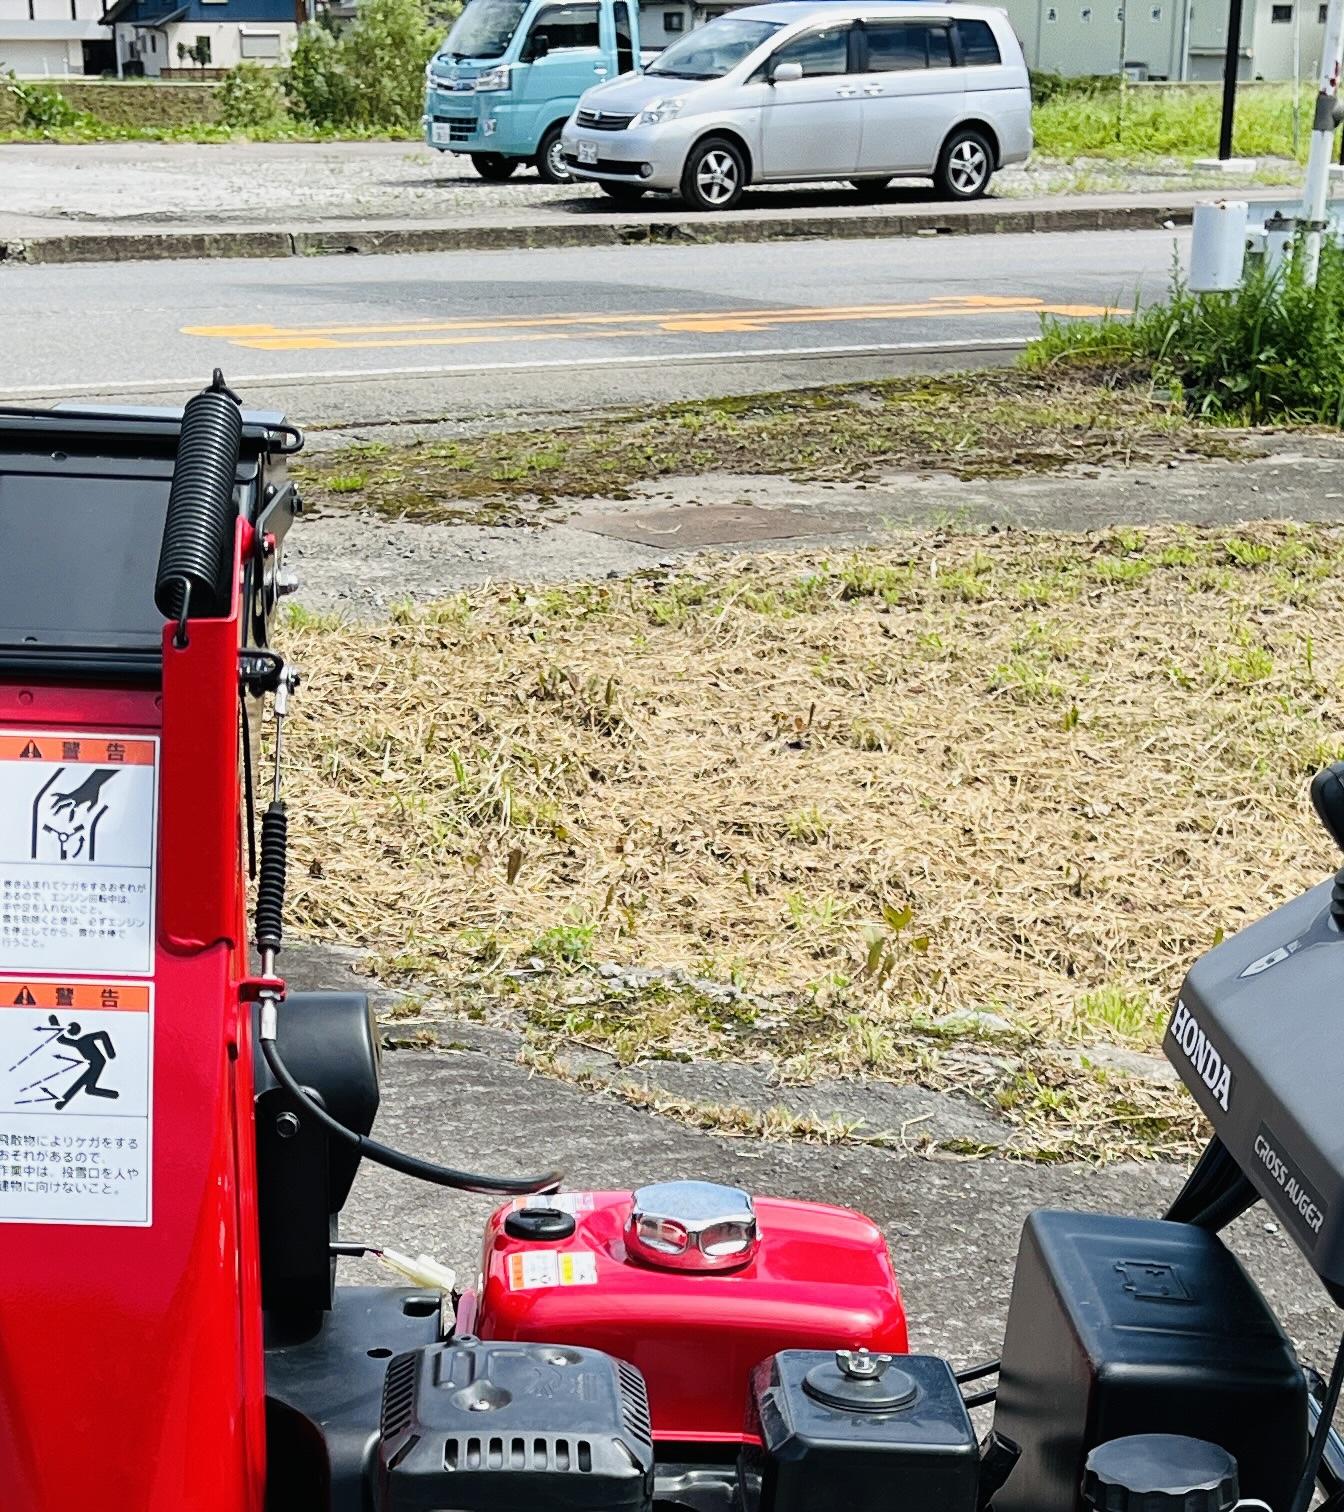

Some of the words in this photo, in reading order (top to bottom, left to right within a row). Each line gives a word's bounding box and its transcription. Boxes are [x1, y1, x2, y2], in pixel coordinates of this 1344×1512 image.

[62, 741, 126, 762] 警告
[55, 987, 120, 1008] 警告
[1170, 998, 1233, 1113] HONDA
[1254, 1134, 1289, 1187] CROSS
[1284, 1177, 1325, 1235] AUGER
